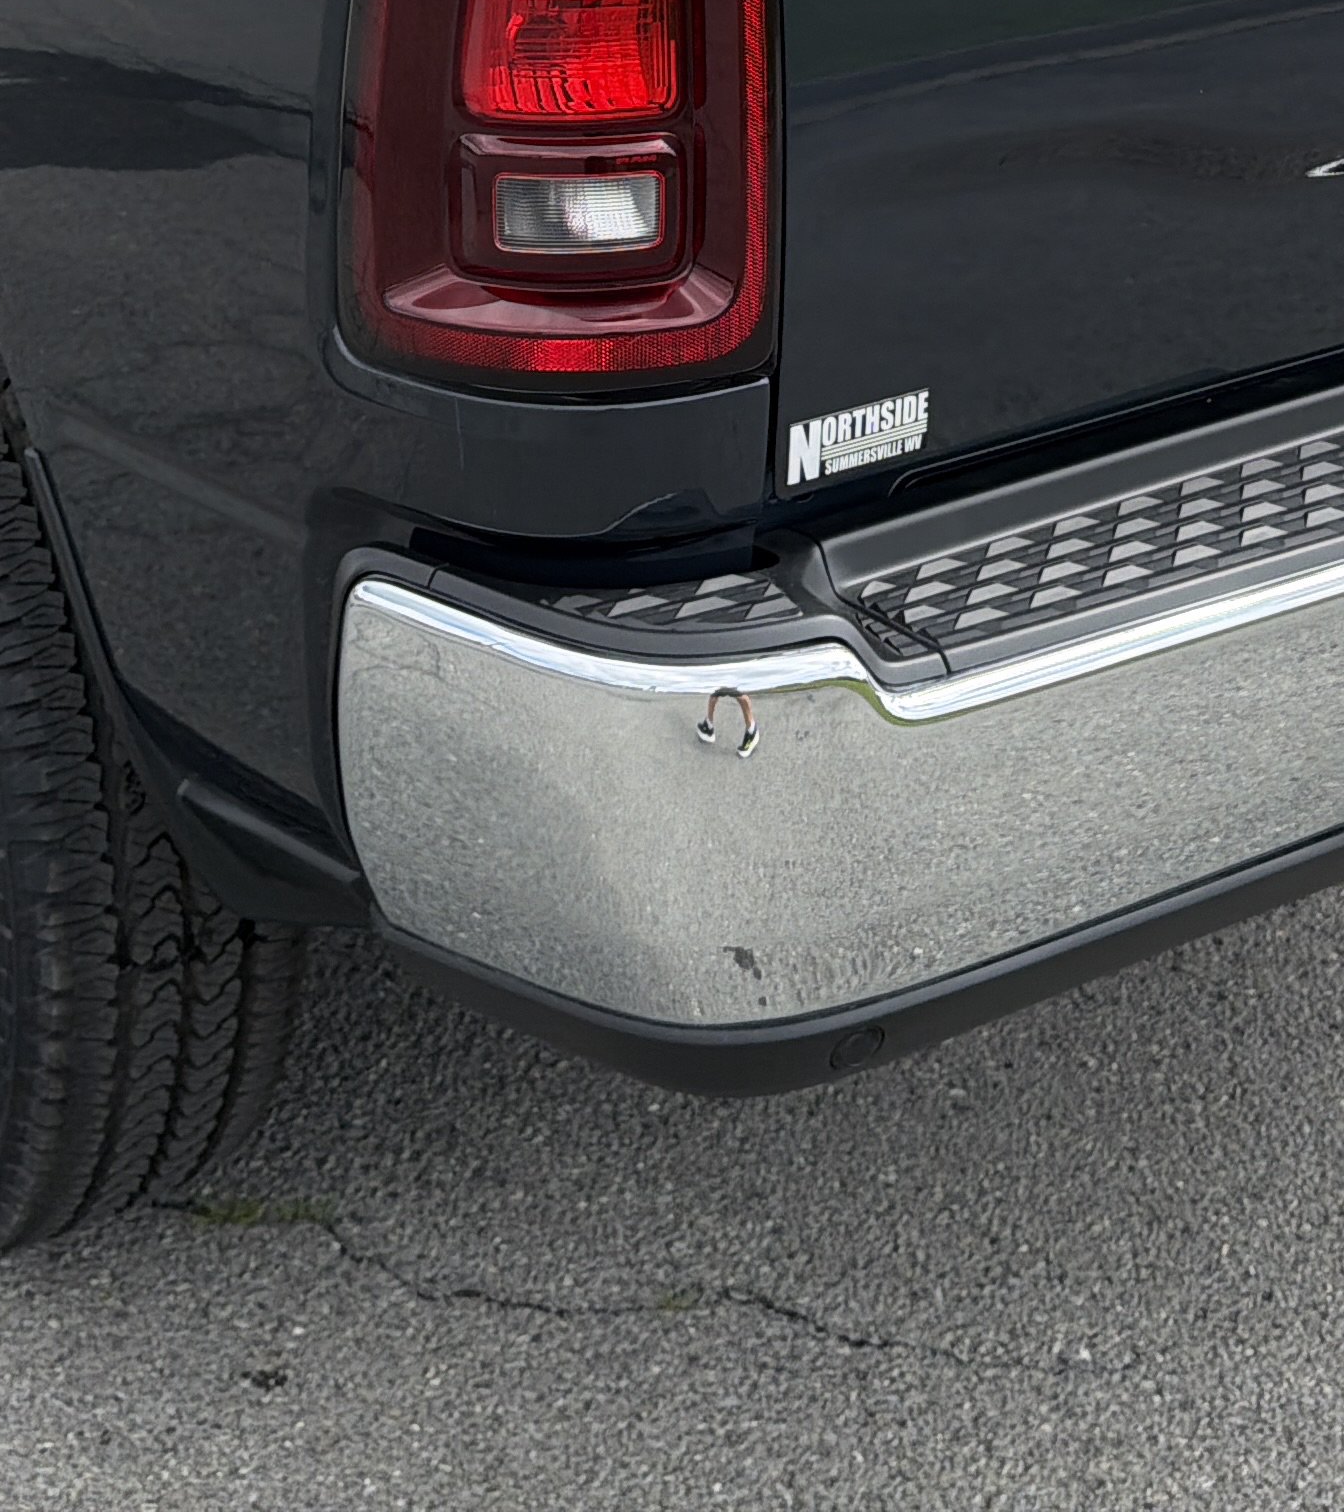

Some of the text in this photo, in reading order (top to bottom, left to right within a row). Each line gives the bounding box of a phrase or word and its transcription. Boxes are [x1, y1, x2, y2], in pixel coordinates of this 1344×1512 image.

[787, 391, 929, 486] NORTHSIDE
[824, 435, 923, 475] SUMMERSVILLE WV
